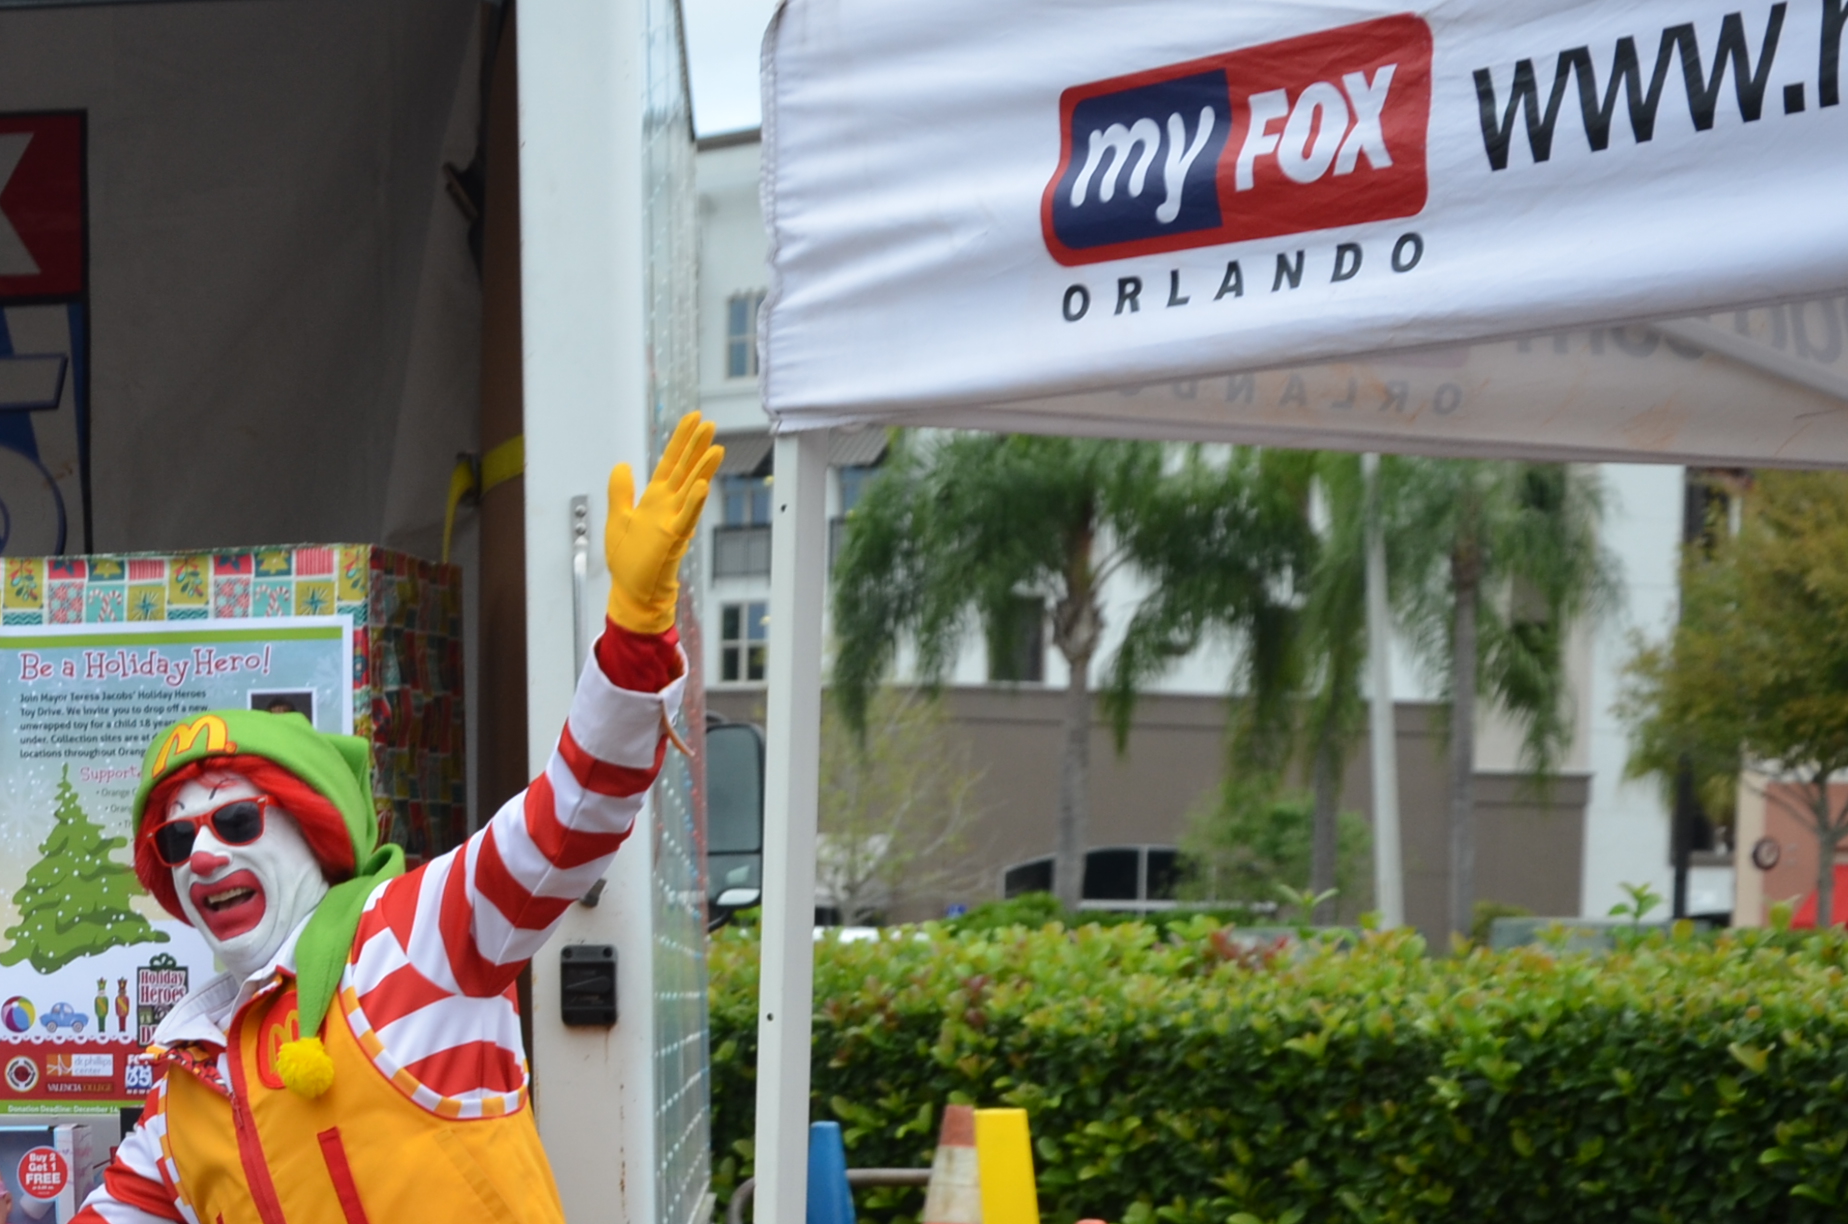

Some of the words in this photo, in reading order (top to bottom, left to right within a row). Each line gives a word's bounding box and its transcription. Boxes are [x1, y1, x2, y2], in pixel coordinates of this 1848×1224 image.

[1072, 105, 1215, 223] my
[1235, 62, 1398, 192] FOX
[1062, 231, 1424, 322] ORLANDO
[21, 653, 52, 680] Be
[63, 661, 75, 677] a
[85, 650, 189, 686] Holiday
[193, 645, 271, 676] Hero!
[140, 970, 185, 986] Holiday
[140, 985, 186, 1005] Heroes
[28, 1162, 48, 1172] Get
[51, 1162, 56, 1172] 1
[29, 1153, 47, 1163] Buy
[49, 1153, 56, 1162] 2
[26, 1172, 61, 1184] FREE
